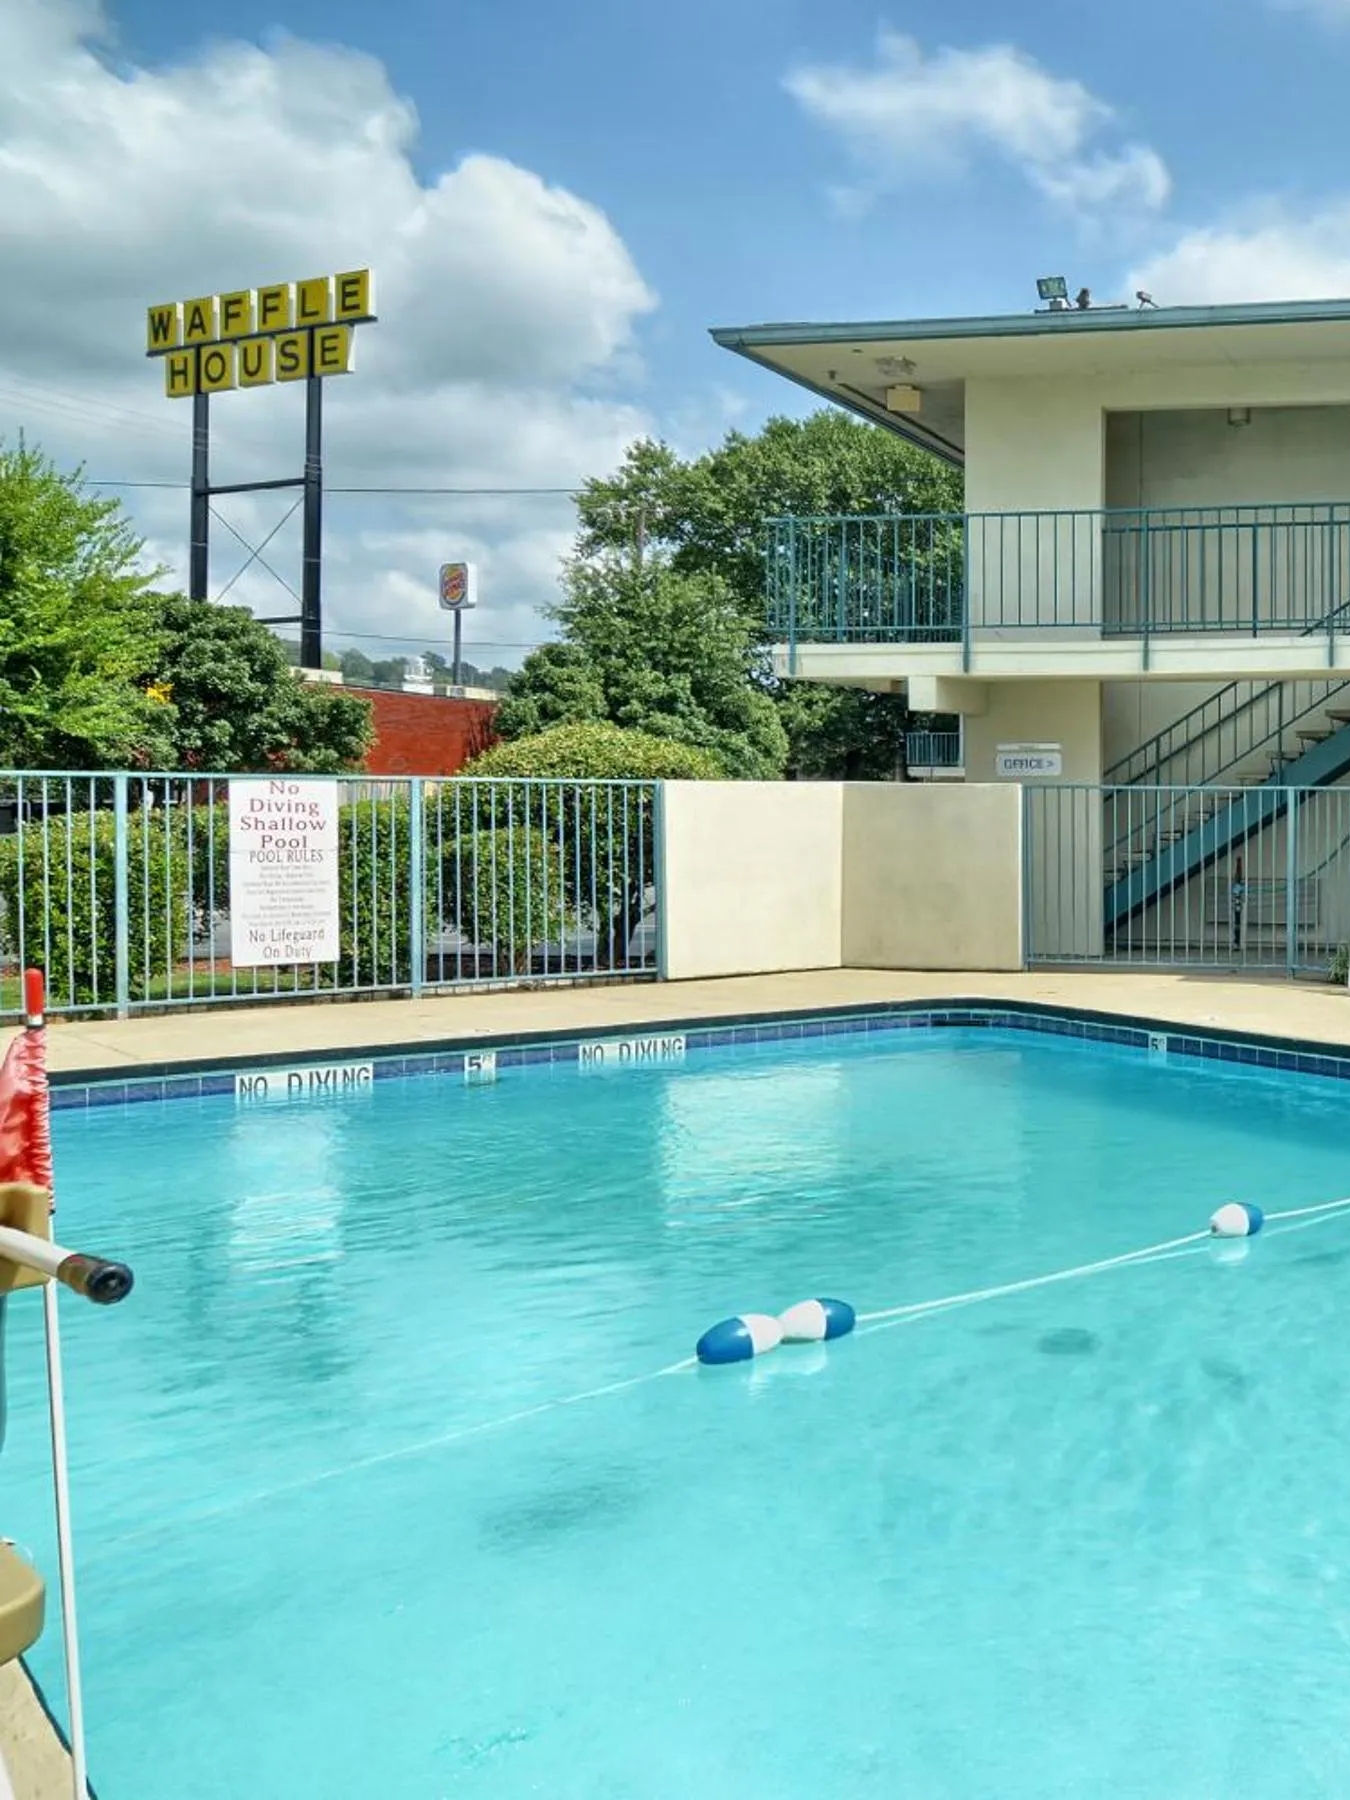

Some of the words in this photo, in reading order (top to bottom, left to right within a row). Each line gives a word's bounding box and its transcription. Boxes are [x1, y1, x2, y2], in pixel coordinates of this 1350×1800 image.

[150, 278, 361, 344] WAFFLE
[169, 334, 340, 391] HOUSE
[1004, 758, 1044, 770] OFFICE
[269, 781, 300, 795] No
[250, 799, 320, 817] Diving
[240, 816, 327, 832] Shallow
[261, 835, 308, 849] Pool
[249, 850, 283, 863] POOL
[287, 849, 324, 862] RULES
[249, 930, 265, 943] No
[271, 928, 325, 944] Lifeguard
[263, 946, 280, 959] On
[285, 945, 312, 959] Duty
[582, 1045, 604, 1060] NO
[619, 1039, 682, 1059] DIVING
[239, 1076, 268, 1093] NO
[288, 1067, 370, 1088] DIVING
